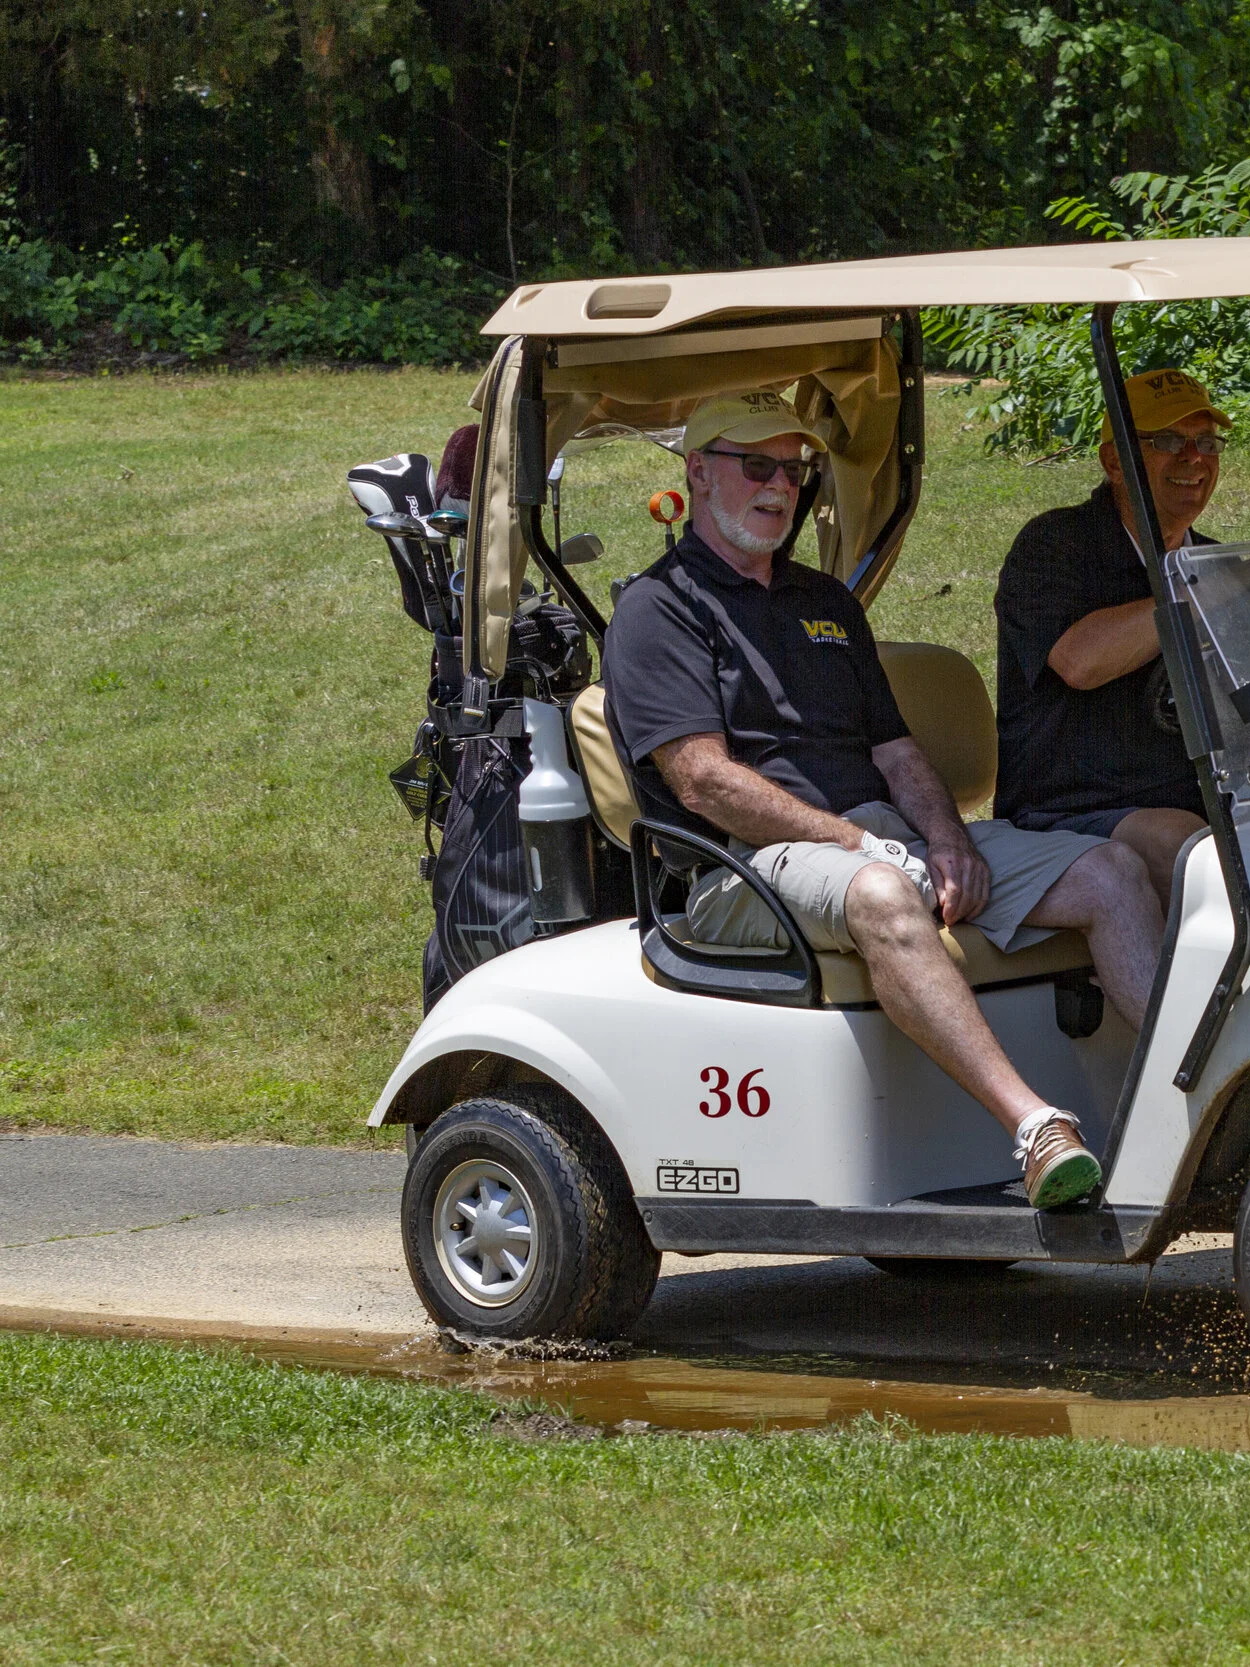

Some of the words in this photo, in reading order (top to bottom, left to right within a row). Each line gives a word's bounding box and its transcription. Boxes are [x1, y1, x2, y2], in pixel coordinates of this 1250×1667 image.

[799, 618, 848, 639] VCU
[699, 1066, 771, 1118] 36
[659, 1158, 679, 1166] TXT
